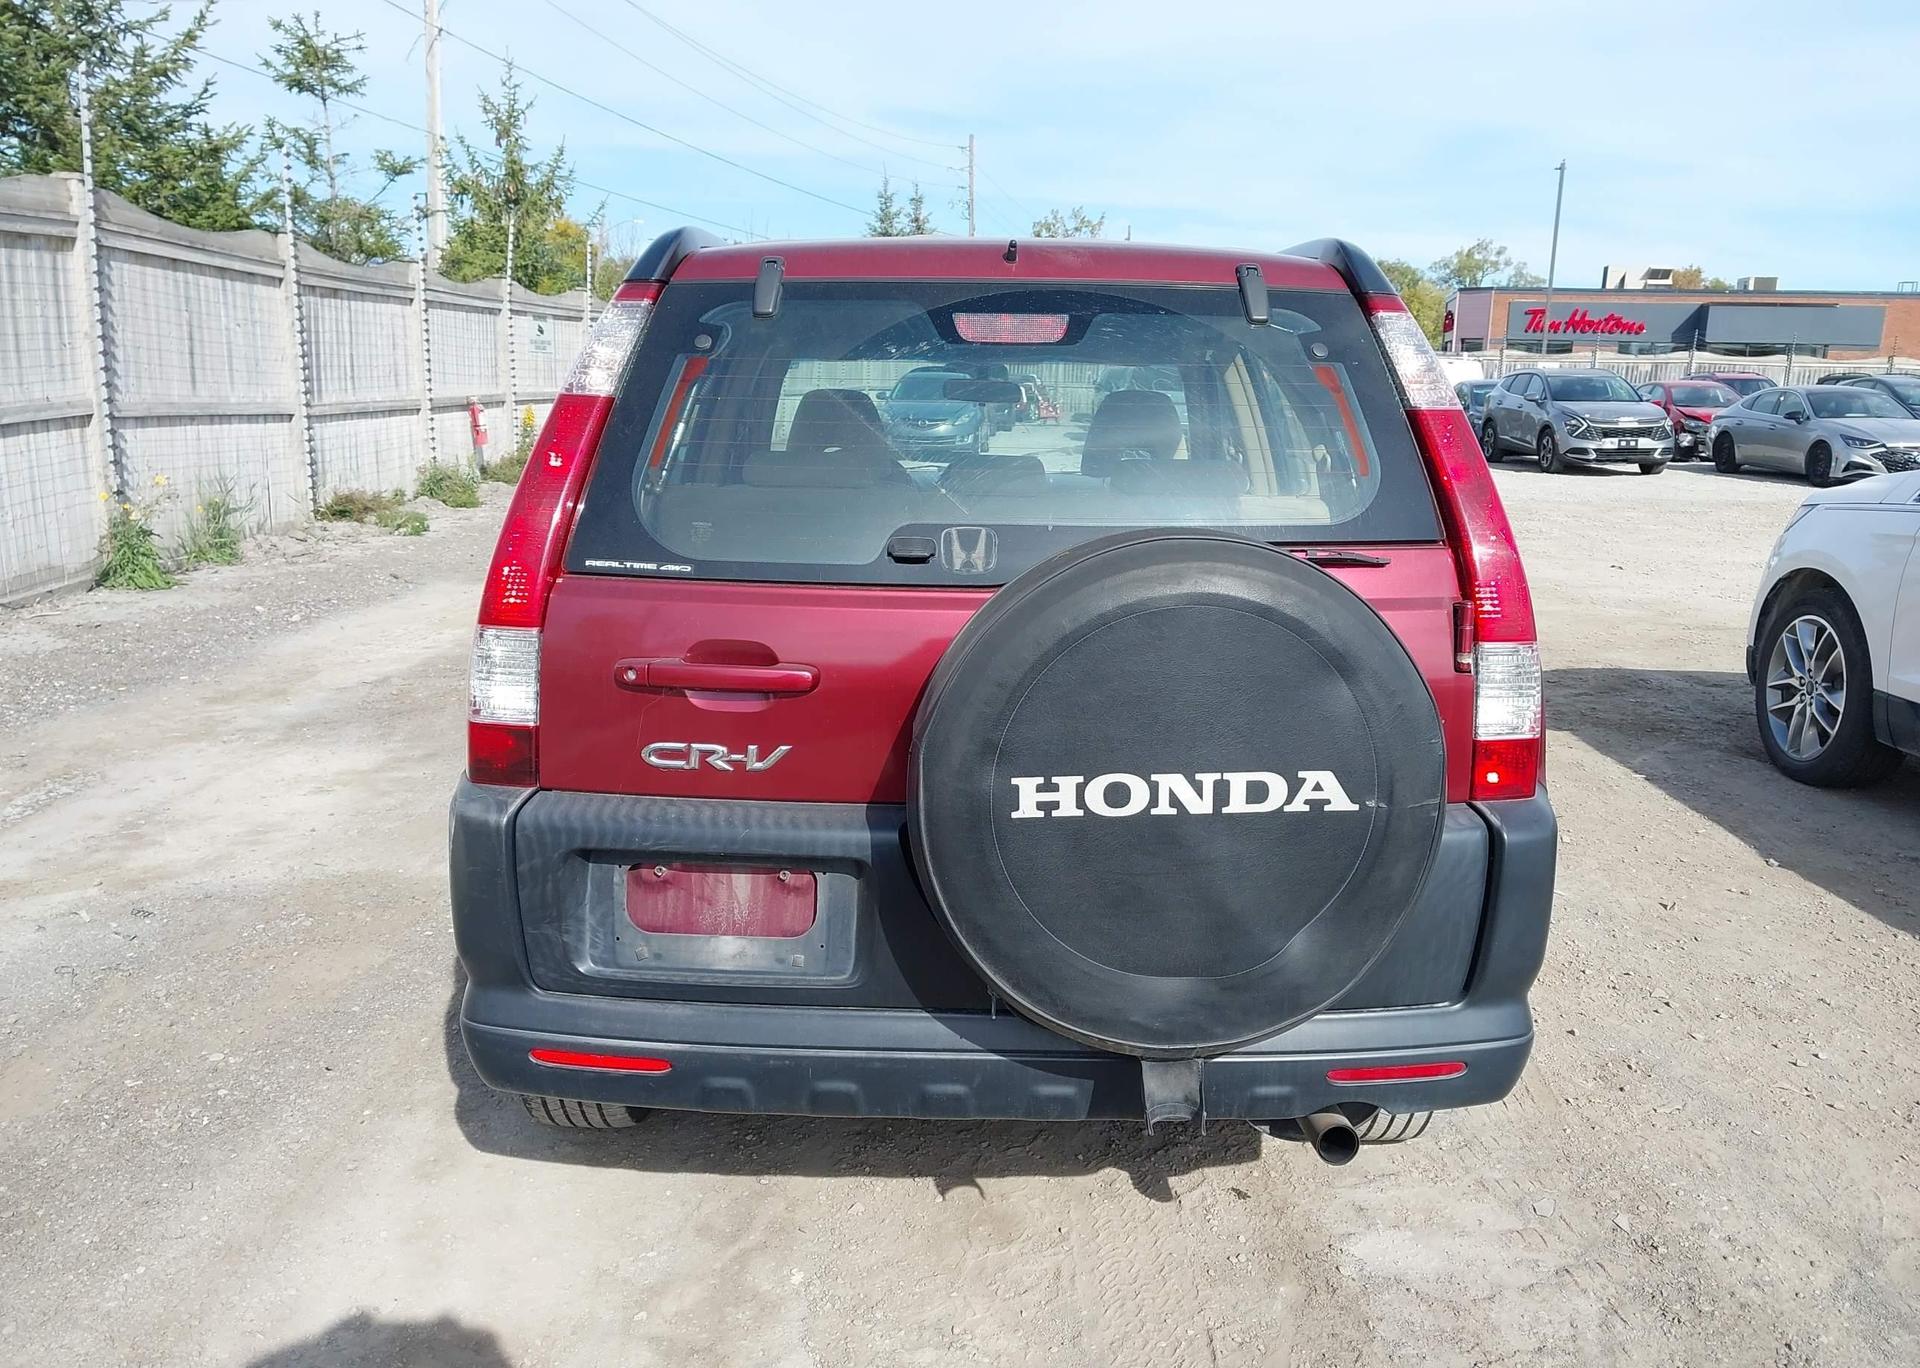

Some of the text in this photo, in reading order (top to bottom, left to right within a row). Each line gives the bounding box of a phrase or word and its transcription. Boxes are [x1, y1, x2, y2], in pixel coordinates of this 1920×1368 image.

[1563, 307, 1646, 335] Hortons
[659, 564, 692, 572] 4WD
[641, 742, 792, 772] CR-V
[1011, 770, 1360, 818] HONDA
